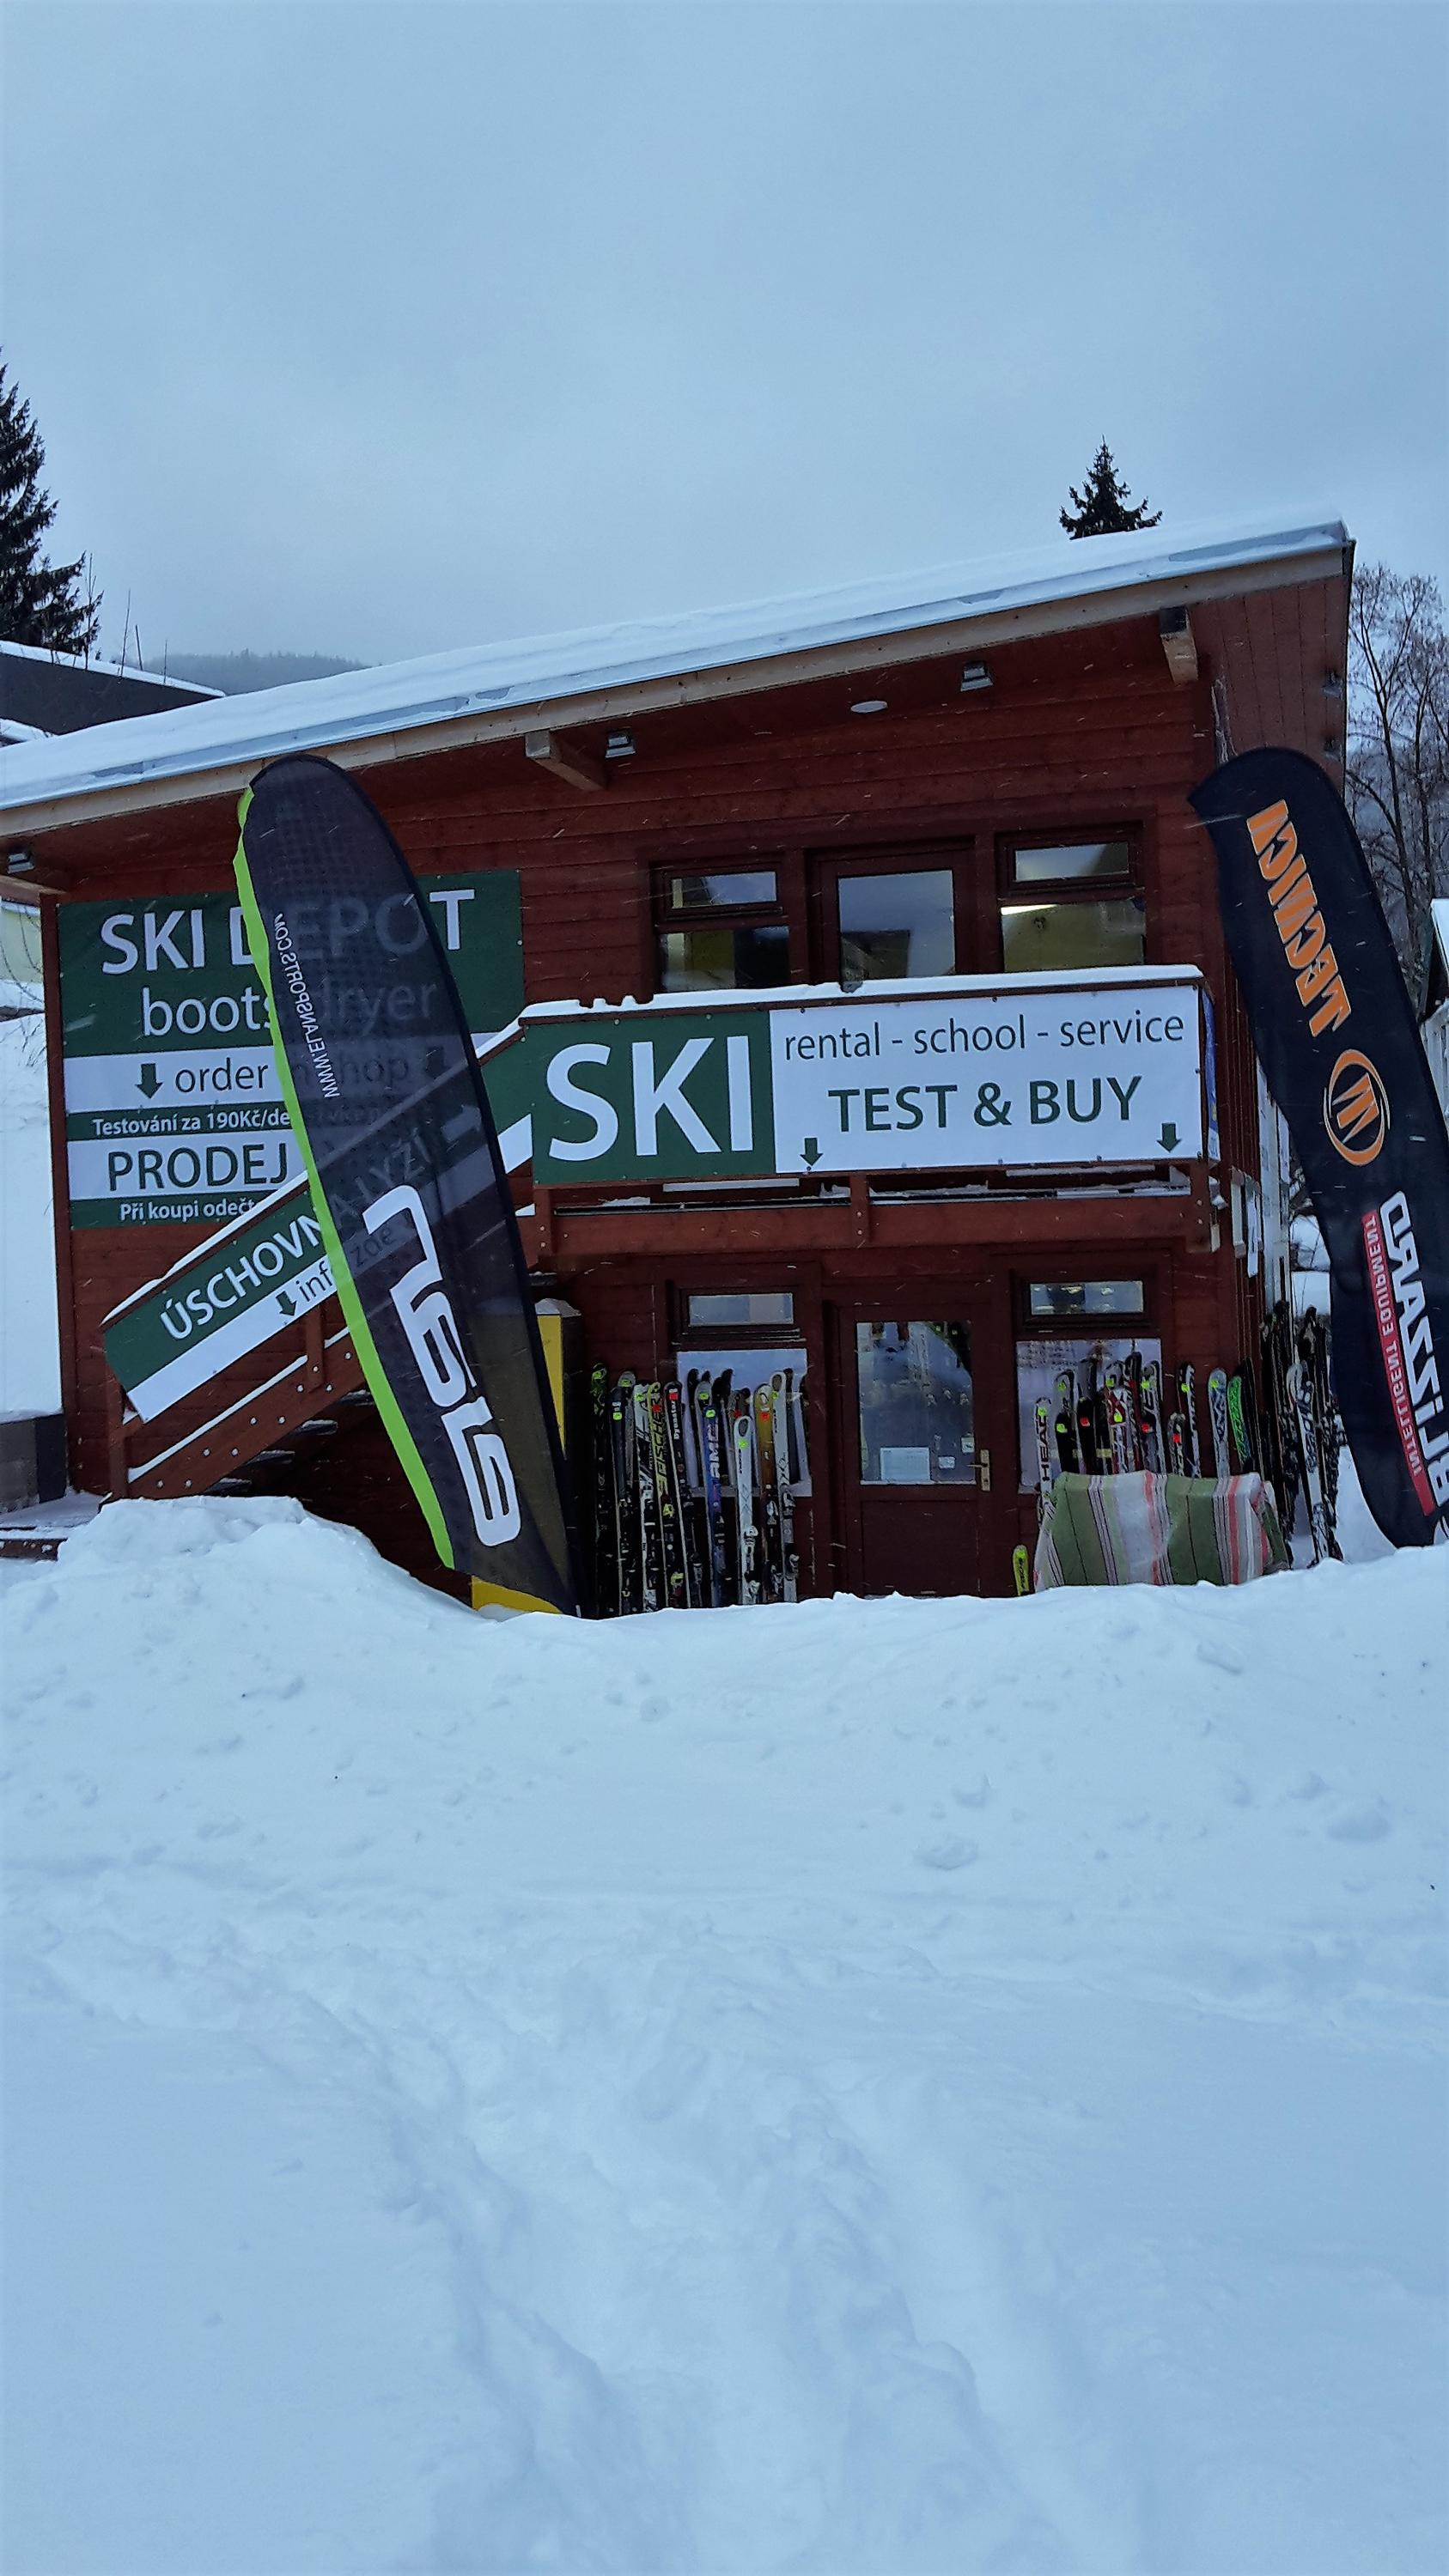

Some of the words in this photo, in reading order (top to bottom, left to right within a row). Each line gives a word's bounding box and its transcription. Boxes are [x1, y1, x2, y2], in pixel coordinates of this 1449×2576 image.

[100, 908, 205, 975] SKI
[783, 1013, 881, 1062] rental
[914, 1013, 1026, 1055] school
[1059, 1009, 1184, 1048] service
[174, 1057, 269, 1094] order
[546, 1034, 754, 1163] SKI
[92, 1114, 178, 1136] Testování
[180, 1116, 201, 1132] za
[207, 1109, 292, 1130] 190Kč/de
[827, 1083, 959, 1133] TEST
[972, 1080, 1012, 1128] &
[1029, 1075, 1143, 1126] BUY
[107, 1142, 288, 1192] PRODEJ
[120, 1201, 144, 1221] Při
[148, 1200, 199, 1222] koupi
[296, 1259, 336, 1303] inf
